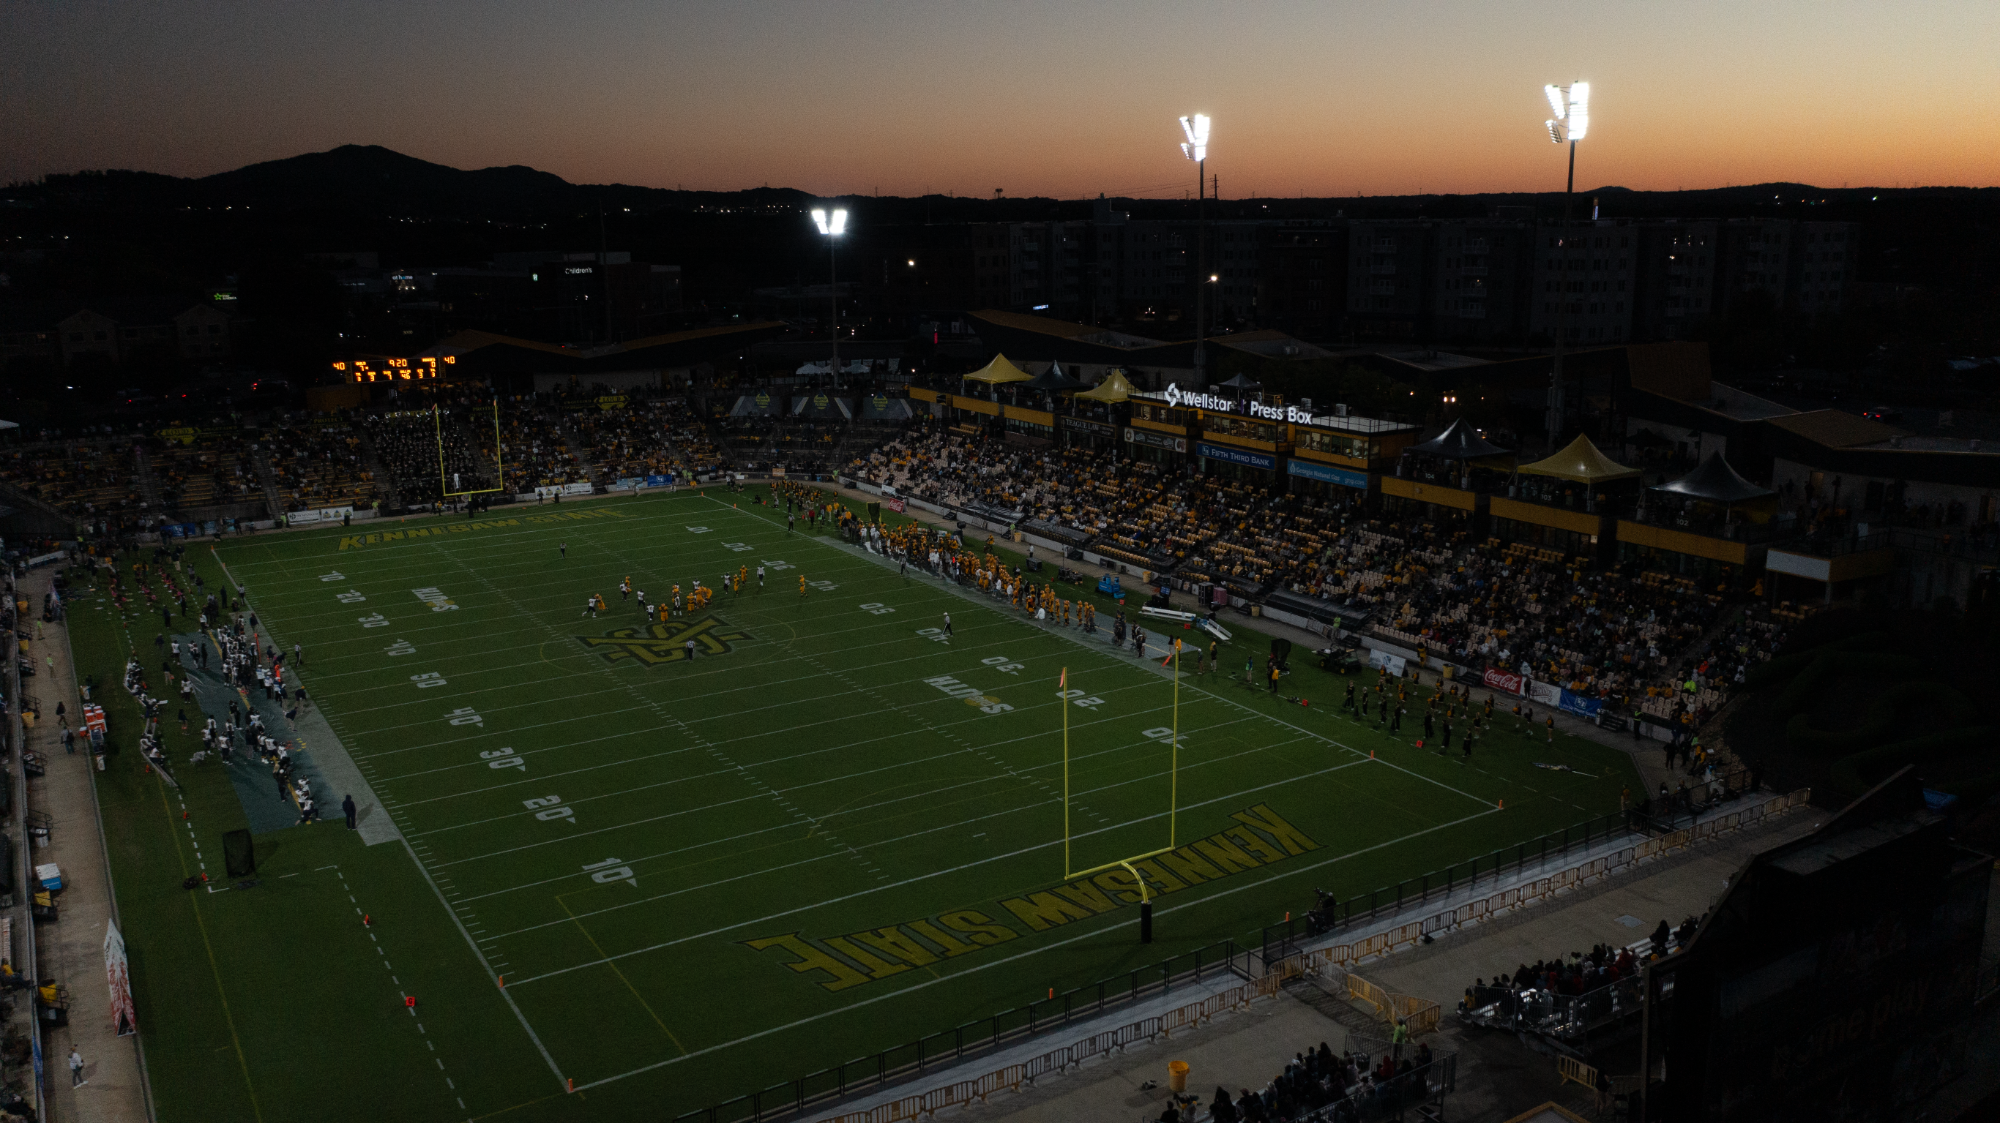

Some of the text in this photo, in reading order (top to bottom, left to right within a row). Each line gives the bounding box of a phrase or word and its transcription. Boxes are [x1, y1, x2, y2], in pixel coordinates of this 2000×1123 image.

[565, 267, 592, 275] Children's
[333, 362, 345, 370] 40
[444, 356, 455, 364] 40
[1182, 391, 1313, 424] Wellstar Press Box
[1066, 419, 1087, 429] TEAGUE
[1088, 422, 1100, 431] LAW
[1211, 448, 1270, 466] FIFTH THIRD BANK
[1296, 466, 1313, 476] Georgia
[1314, 470, 1330, 479] Natural
[339, 508, 634, 550] KENNESAW STATE
[1676, 518, 1689, 527] 102
[318, 571, 346, 582] 10
[336, 590, 366, 603] 20
[859, 602, 895, 615] 50
[358, 613, 390, 628] 30
[383, 641, 417, 656] 40
[981, 656, 1024, 672] 30
[410, 671, 448, 688] 50
[1485, 669, 1520, 690] Coca-Cola
[1056, 689, 1105, 707] 20
[443, 706, 483, 726] 40
[479, 747, 525, 770] 30
[522, 794, 574, 821] 20
[581, 857, 634, 884] 10
[732, 801, 1330, 993] KENNESAW STATE
